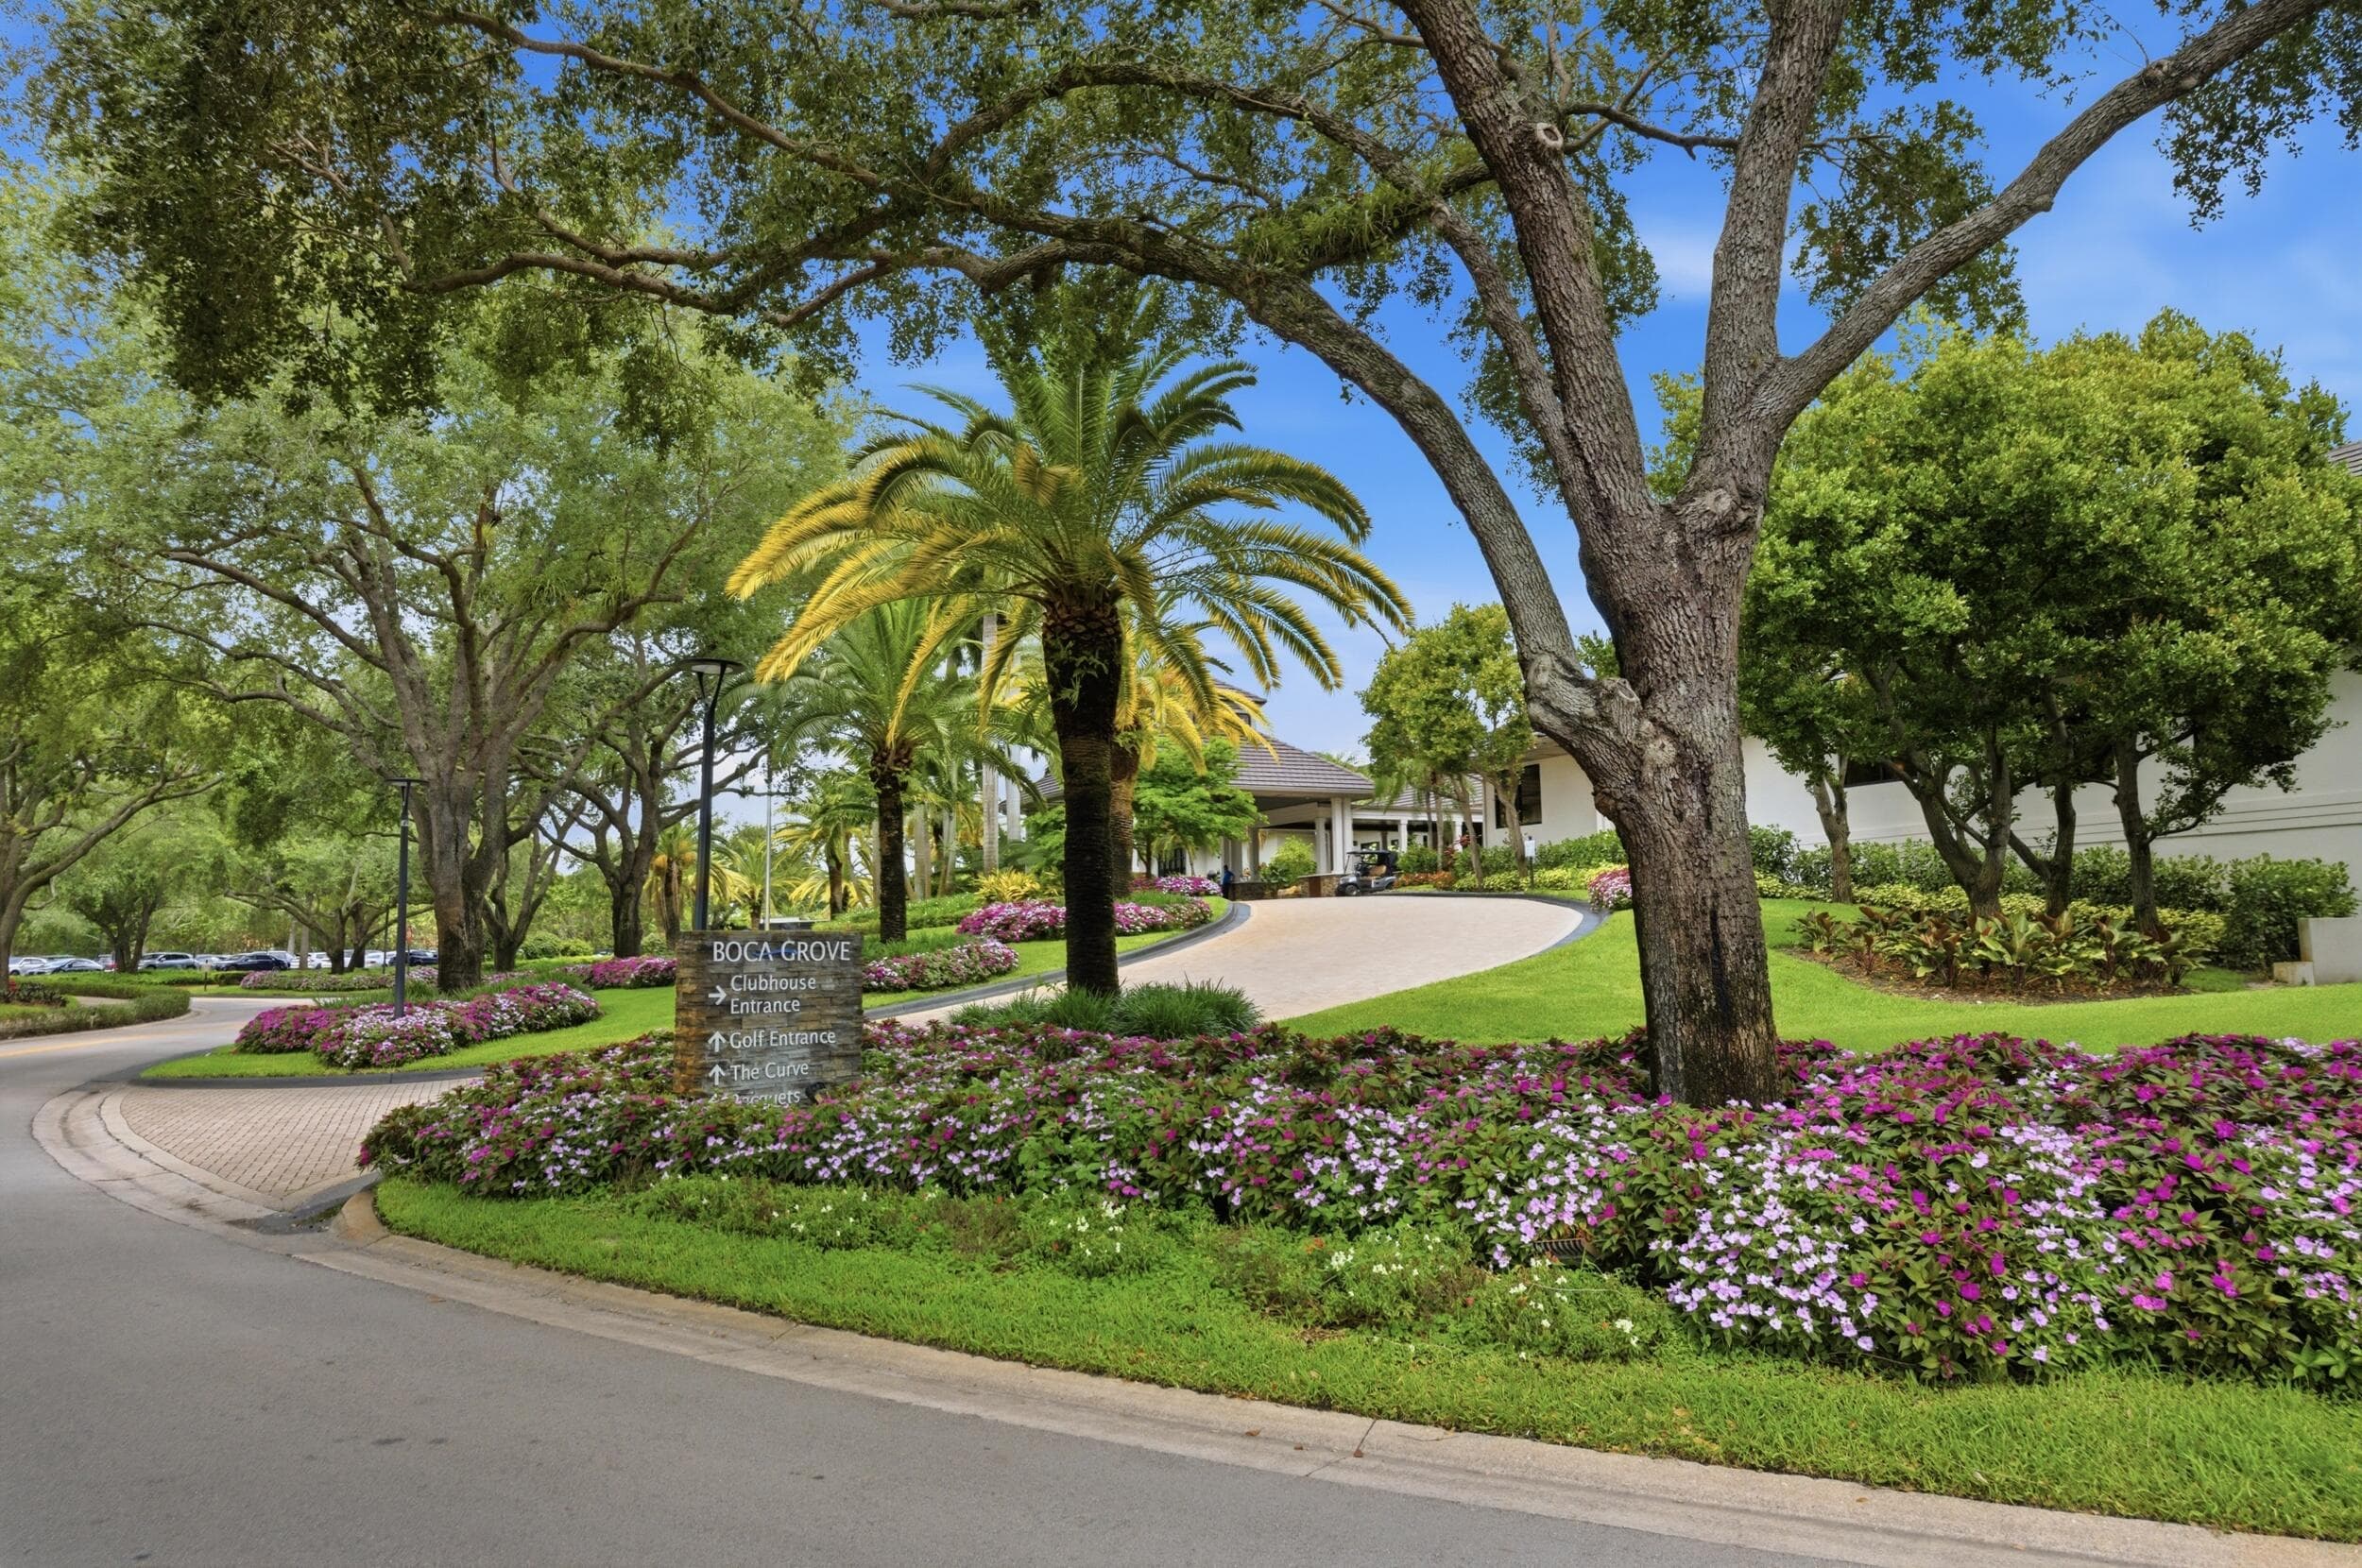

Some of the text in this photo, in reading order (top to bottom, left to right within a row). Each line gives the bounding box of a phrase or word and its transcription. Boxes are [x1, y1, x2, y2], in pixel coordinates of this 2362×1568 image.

[712, 940, 851, 963] BOCA GROVE
[729, 975, 817, 992] Clubhouse
[730, 998, 800, 1014] Entrance
[729, 1030, 836, 1049] Golf Entrance
[730, 1063, 810, 1082] The Curve
